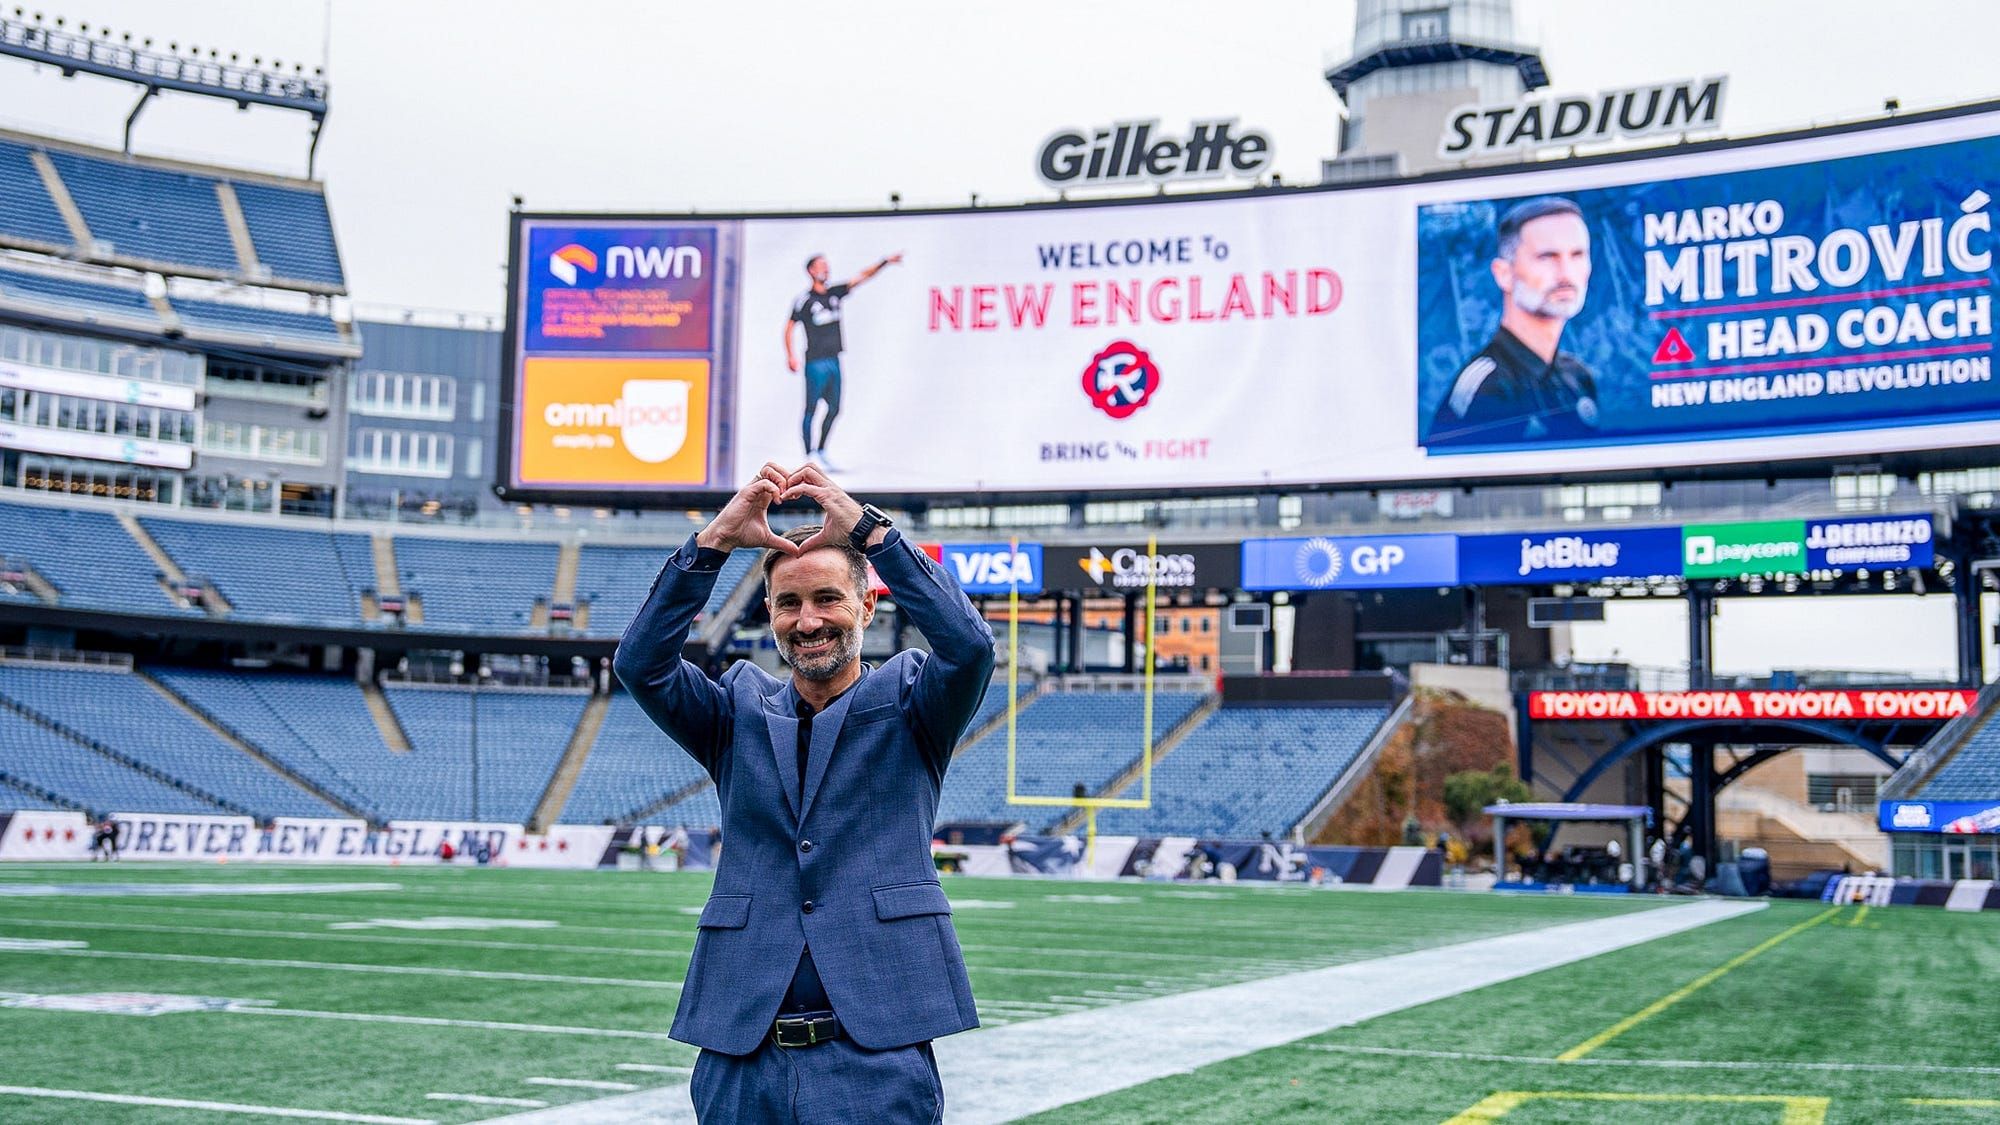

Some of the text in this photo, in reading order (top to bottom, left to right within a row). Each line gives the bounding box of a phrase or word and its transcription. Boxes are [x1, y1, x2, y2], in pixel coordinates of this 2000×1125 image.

[1446, 81, 1721, 152] STADIUM
[1039, 121, 1269, 183] Gillette
[1644, 200, 1784, 246] MARKO
[606, 245, 702, 279] nwn
[1037, 237, 1193, 270] WELCOME
[1644, 189, 1992, 306] MITROVIĆ
[928, 268, 1344, 332] NEW ENGLAND
[1707, 295, 1992, 361] HEAD COACH
[1652, 356, 1991, 408] NEW ENGLAND REVOLUTION
[544, 398, 682, 427] omnipod
[1040, 440, 1110, 462] BRING
[1144, 438, 1209, 460] FIGHT
[951, 552, 1033, 584] VISA
[1519, 537, 1619, 575] jetBlue
[1716, 542, 1799, 563] paycom
[1542, 692, 1968, 717] TOYOTA TOYOTA TOYOTA TOYOTA
[88, 820, 248, 853] OREVER
